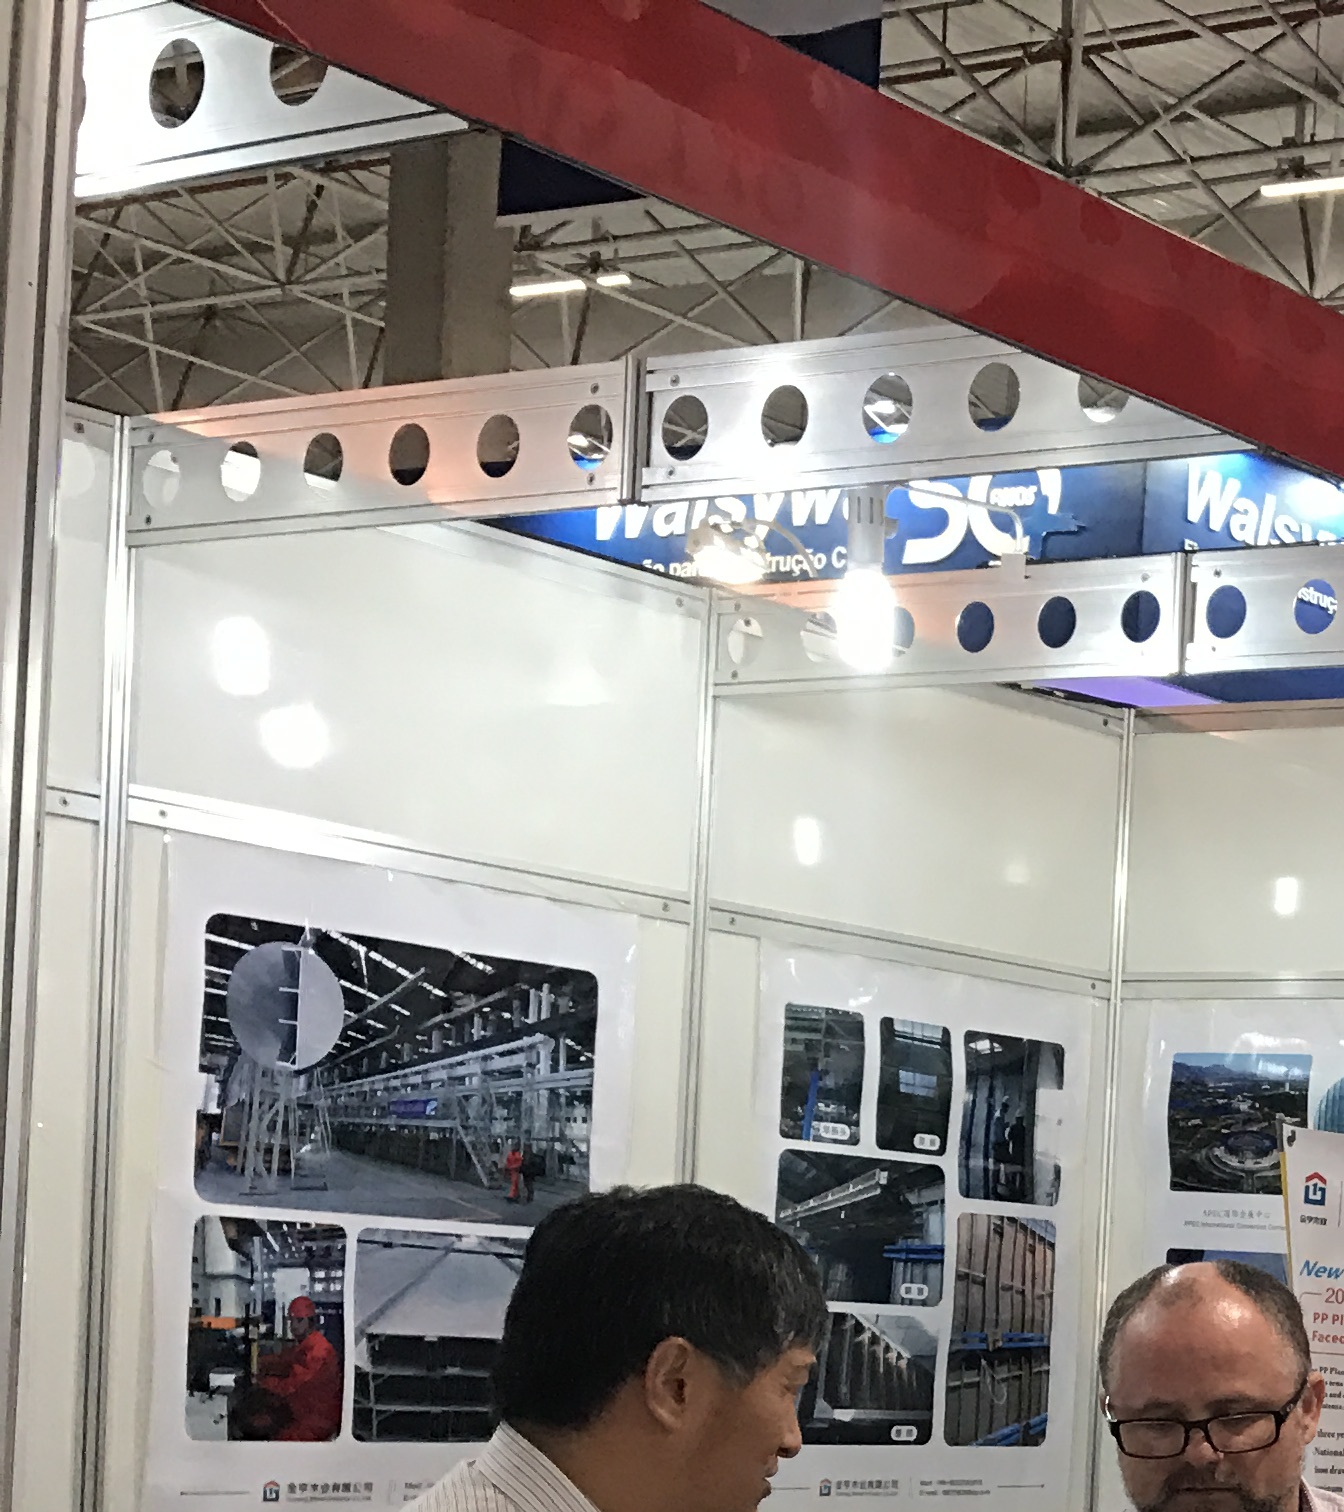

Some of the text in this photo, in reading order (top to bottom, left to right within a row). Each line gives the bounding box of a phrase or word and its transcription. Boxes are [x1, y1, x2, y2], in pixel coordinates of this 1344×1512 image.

[1300, 1260, 1344, 1279] New
[1313, 1312, 1328, 1324] PP
[1317, 1429, 1335, 1438] three
